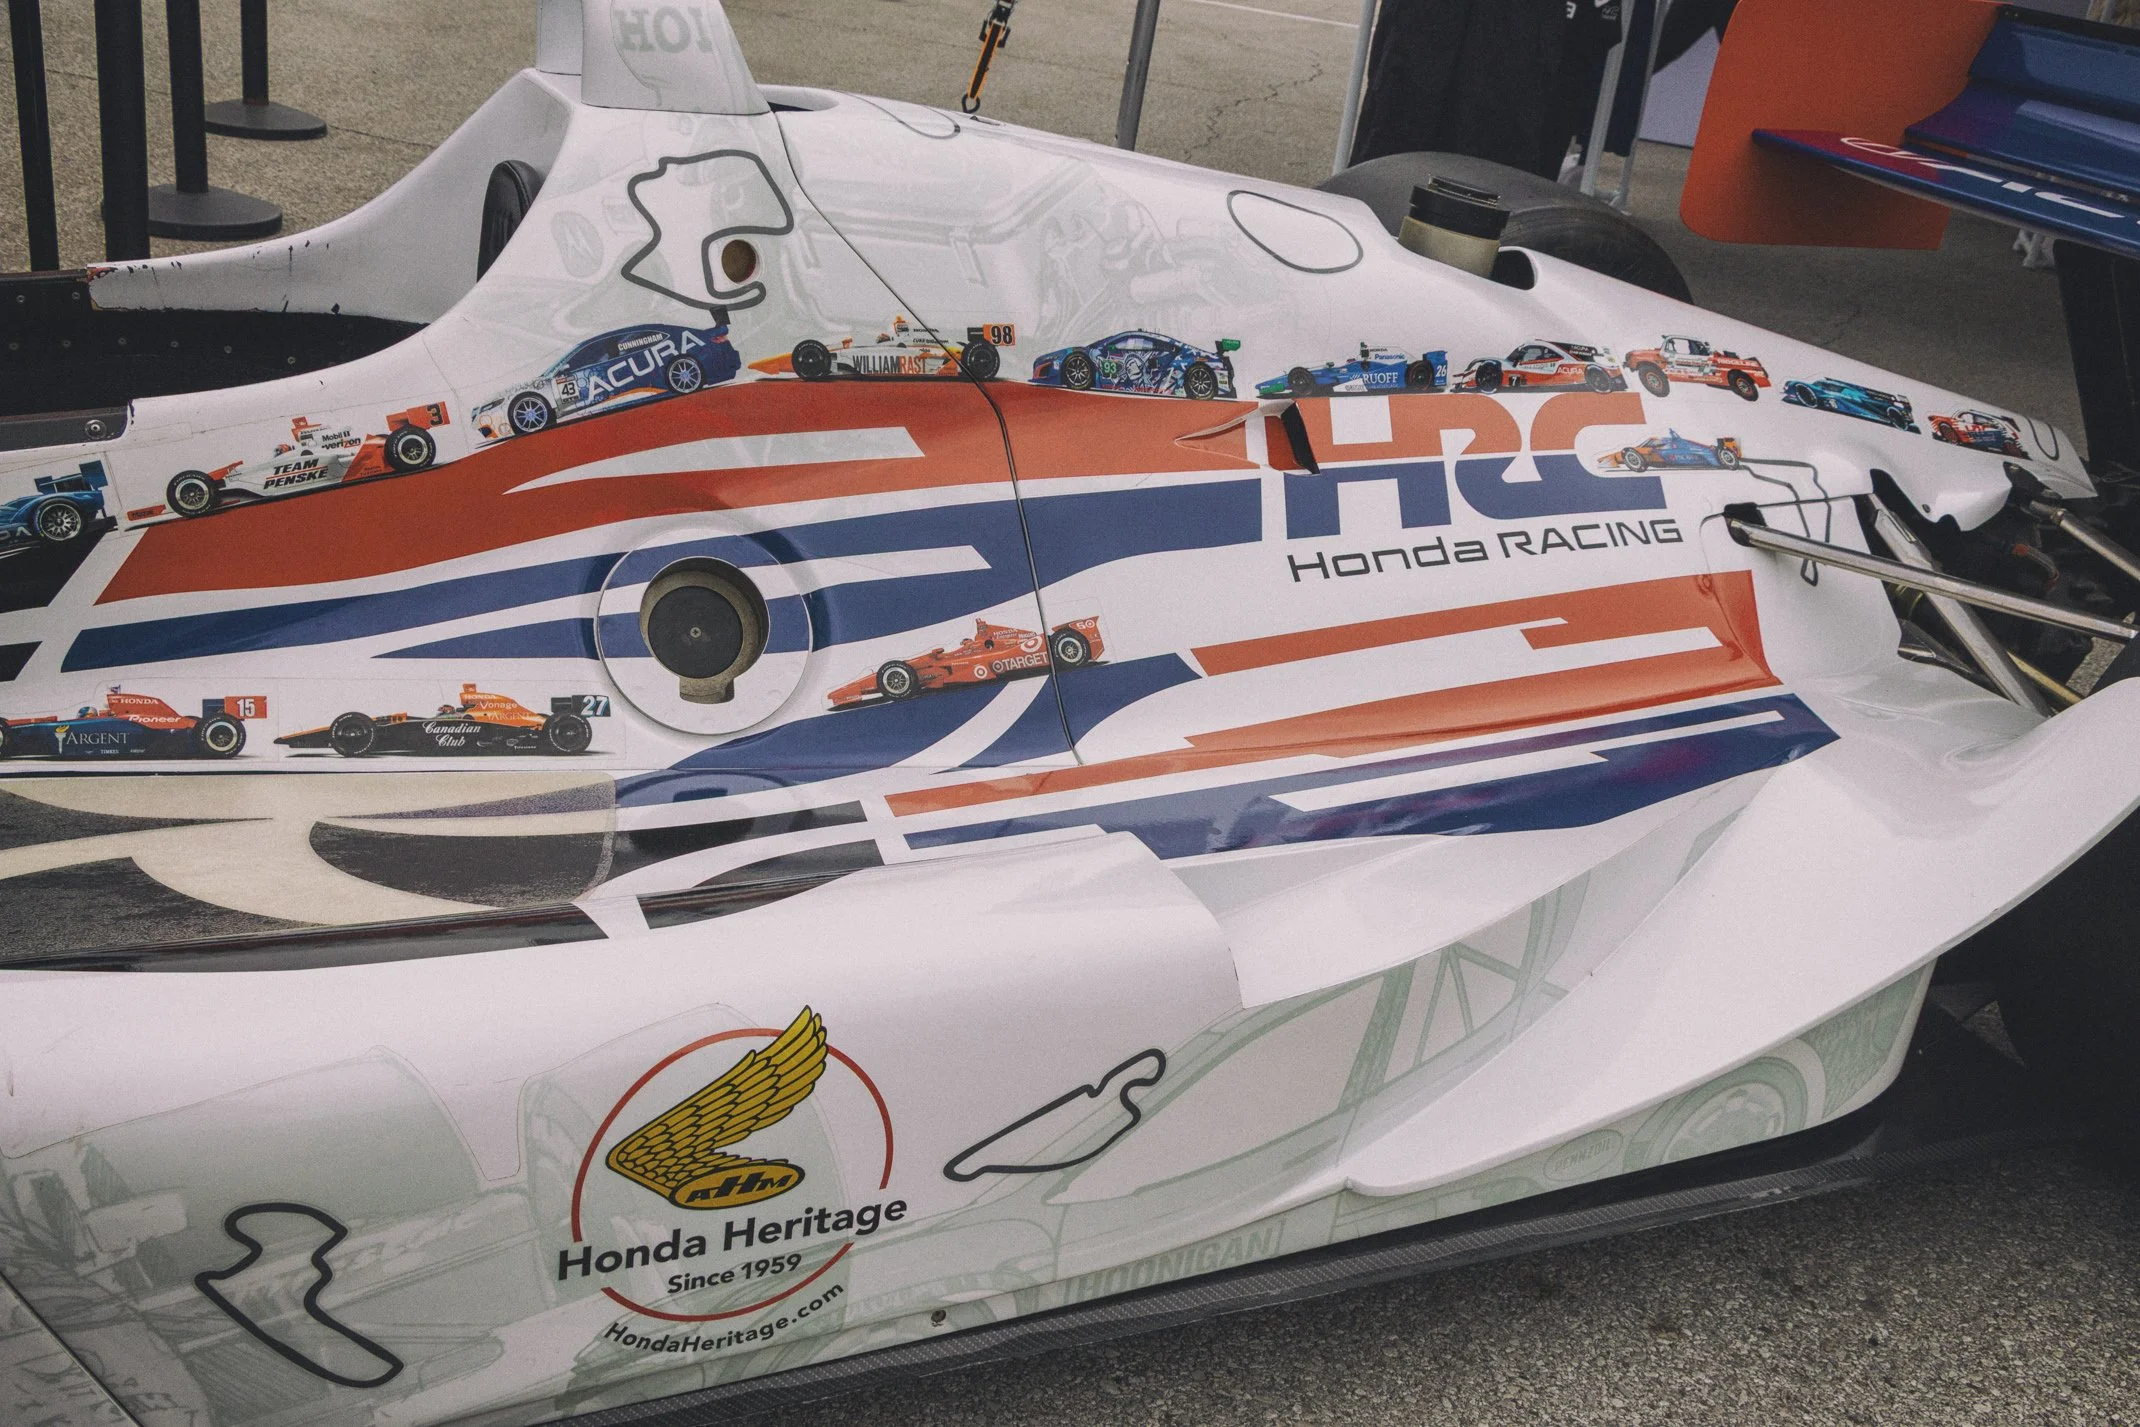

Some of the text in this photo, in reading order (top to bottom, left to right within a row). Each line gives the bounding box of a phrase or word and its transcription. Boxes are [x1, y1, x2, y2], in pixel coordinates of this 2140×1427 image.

[617, 332, 664, 352] CUNNINGHAM
[990, 325, 1012, 345] 98
[588, 330, 706, 400] ACURA
[1103, 361, 1118, 375] 93
[1436, 365, 1447, 379] 26
[1362, 372, 1399, 385] RUOFF
[561, 382, 576, 397] 43
[427, 402, 444, 426] 3
[322, 431, 342, 442] Mobil
[273, 458, 319, 475] TEAM
[1265, 391, 1668, 540] HRC
[263, 468, 329, 490] PENSKE
[1287, 518, 1684, 583] Honda RACING
[1002, 652, 1049, 673] TARGET
[120, 697, 159, 705] HONDA
[237, 698, 255, 717] 15
[480, 701, 518, 710] Vonage
[581, 695, 608, 717] 27
[128, 714, 181, 724] Pioneer
[422, 721, 481, 734] Canadian
[66, 731, 129, 745] ARGENT
[436, 734, 467, 748] Club
[684, 1172, 791, 1204] AHM
[558, 1199, 907, 1281] Honda Heritage
[667, 1253, 803, 1294] Since 1959
[603, 1283, 845, 1353] HondaHeritage.com
